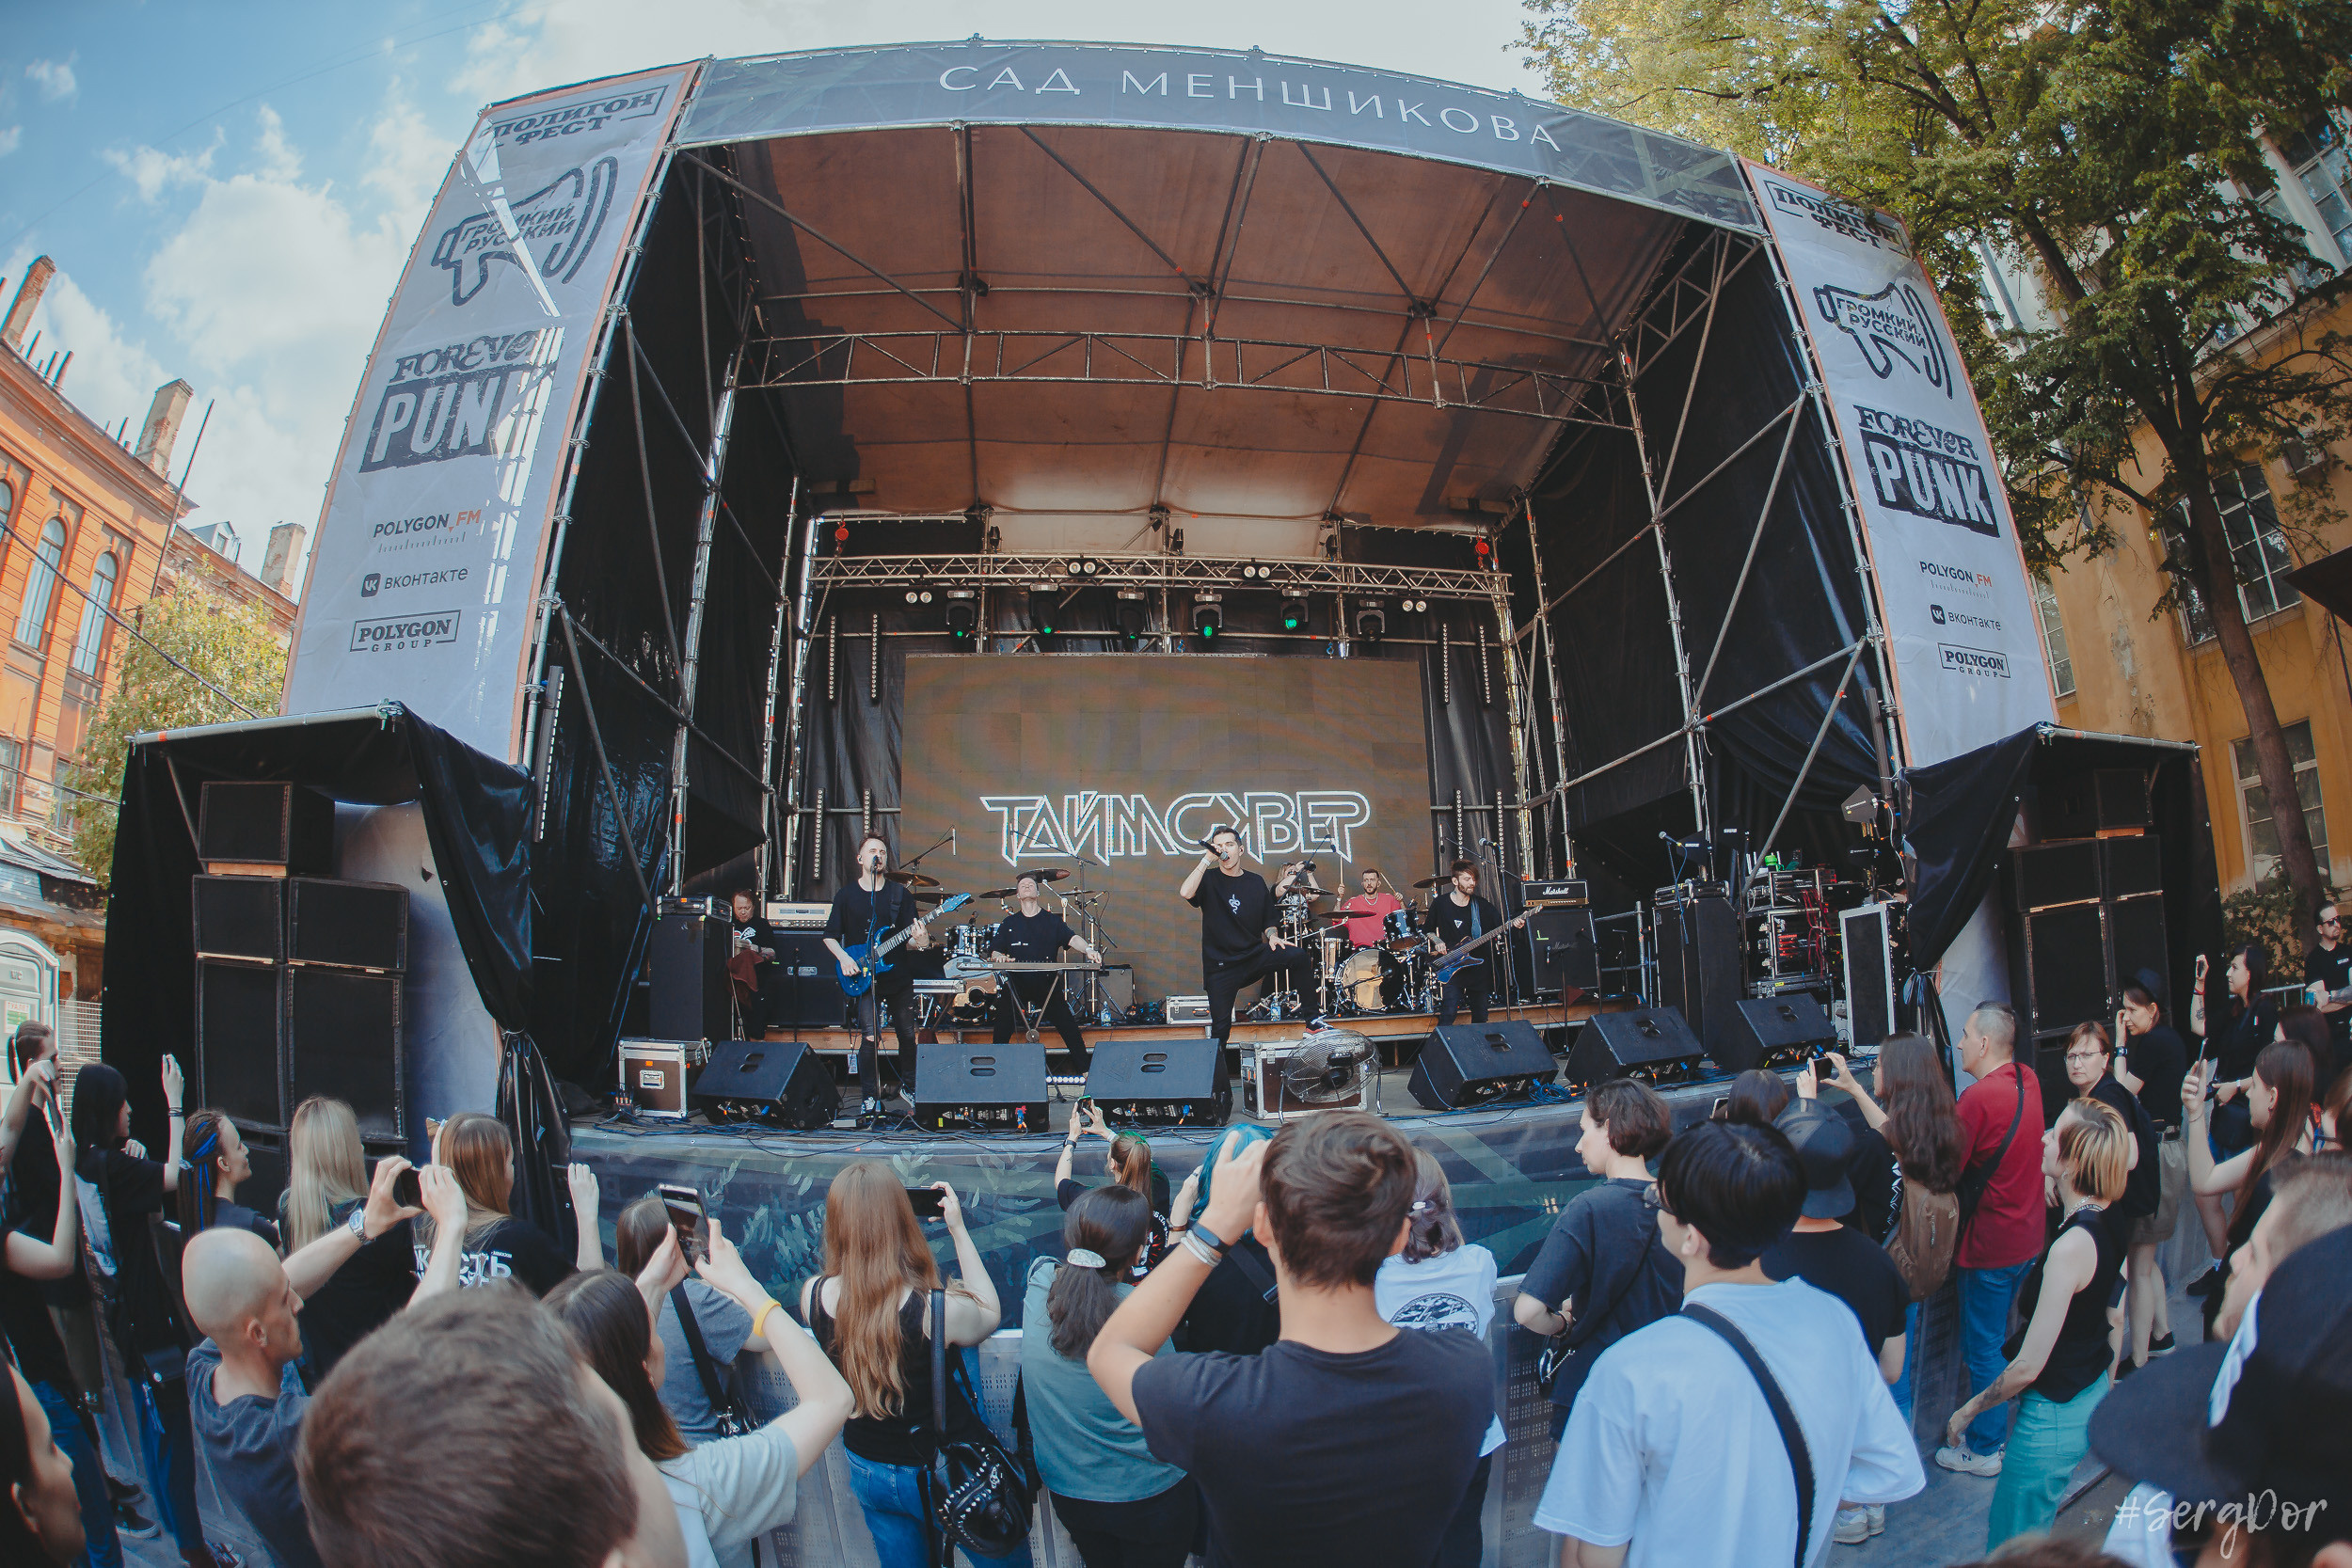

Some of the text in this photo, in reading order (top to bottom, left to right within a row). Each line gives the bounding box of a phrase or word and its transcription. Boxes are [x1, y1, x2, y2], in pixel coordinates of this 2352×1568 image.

[492, 92, 658, 138] ПОЛИГОН
[939, 66, 1561, 152] САД МЕНШИКОВА
[515, 115, 612, 146] ФЕСТ
[1811, 213, 1881, 249] ФЕСТ
[1836, 297, 1917, 334] ГРОМКИЙ
[1849, 312, 1927, 349] РУССКИЙ
[1868, 440, 1994, 525] PUNK
[373, 514, 450, 538] POLYGON
[1919, 561, 1974, 583] POLYGON
[358, 619, 452, 642] POLYGON
[371, 639, 432, 652] GROUP
[1945, 650, 2004, 671] POLYGON
[1959, 666, 1998, 677] GROUP
[1542, 886, 1569, 895] Marshall
